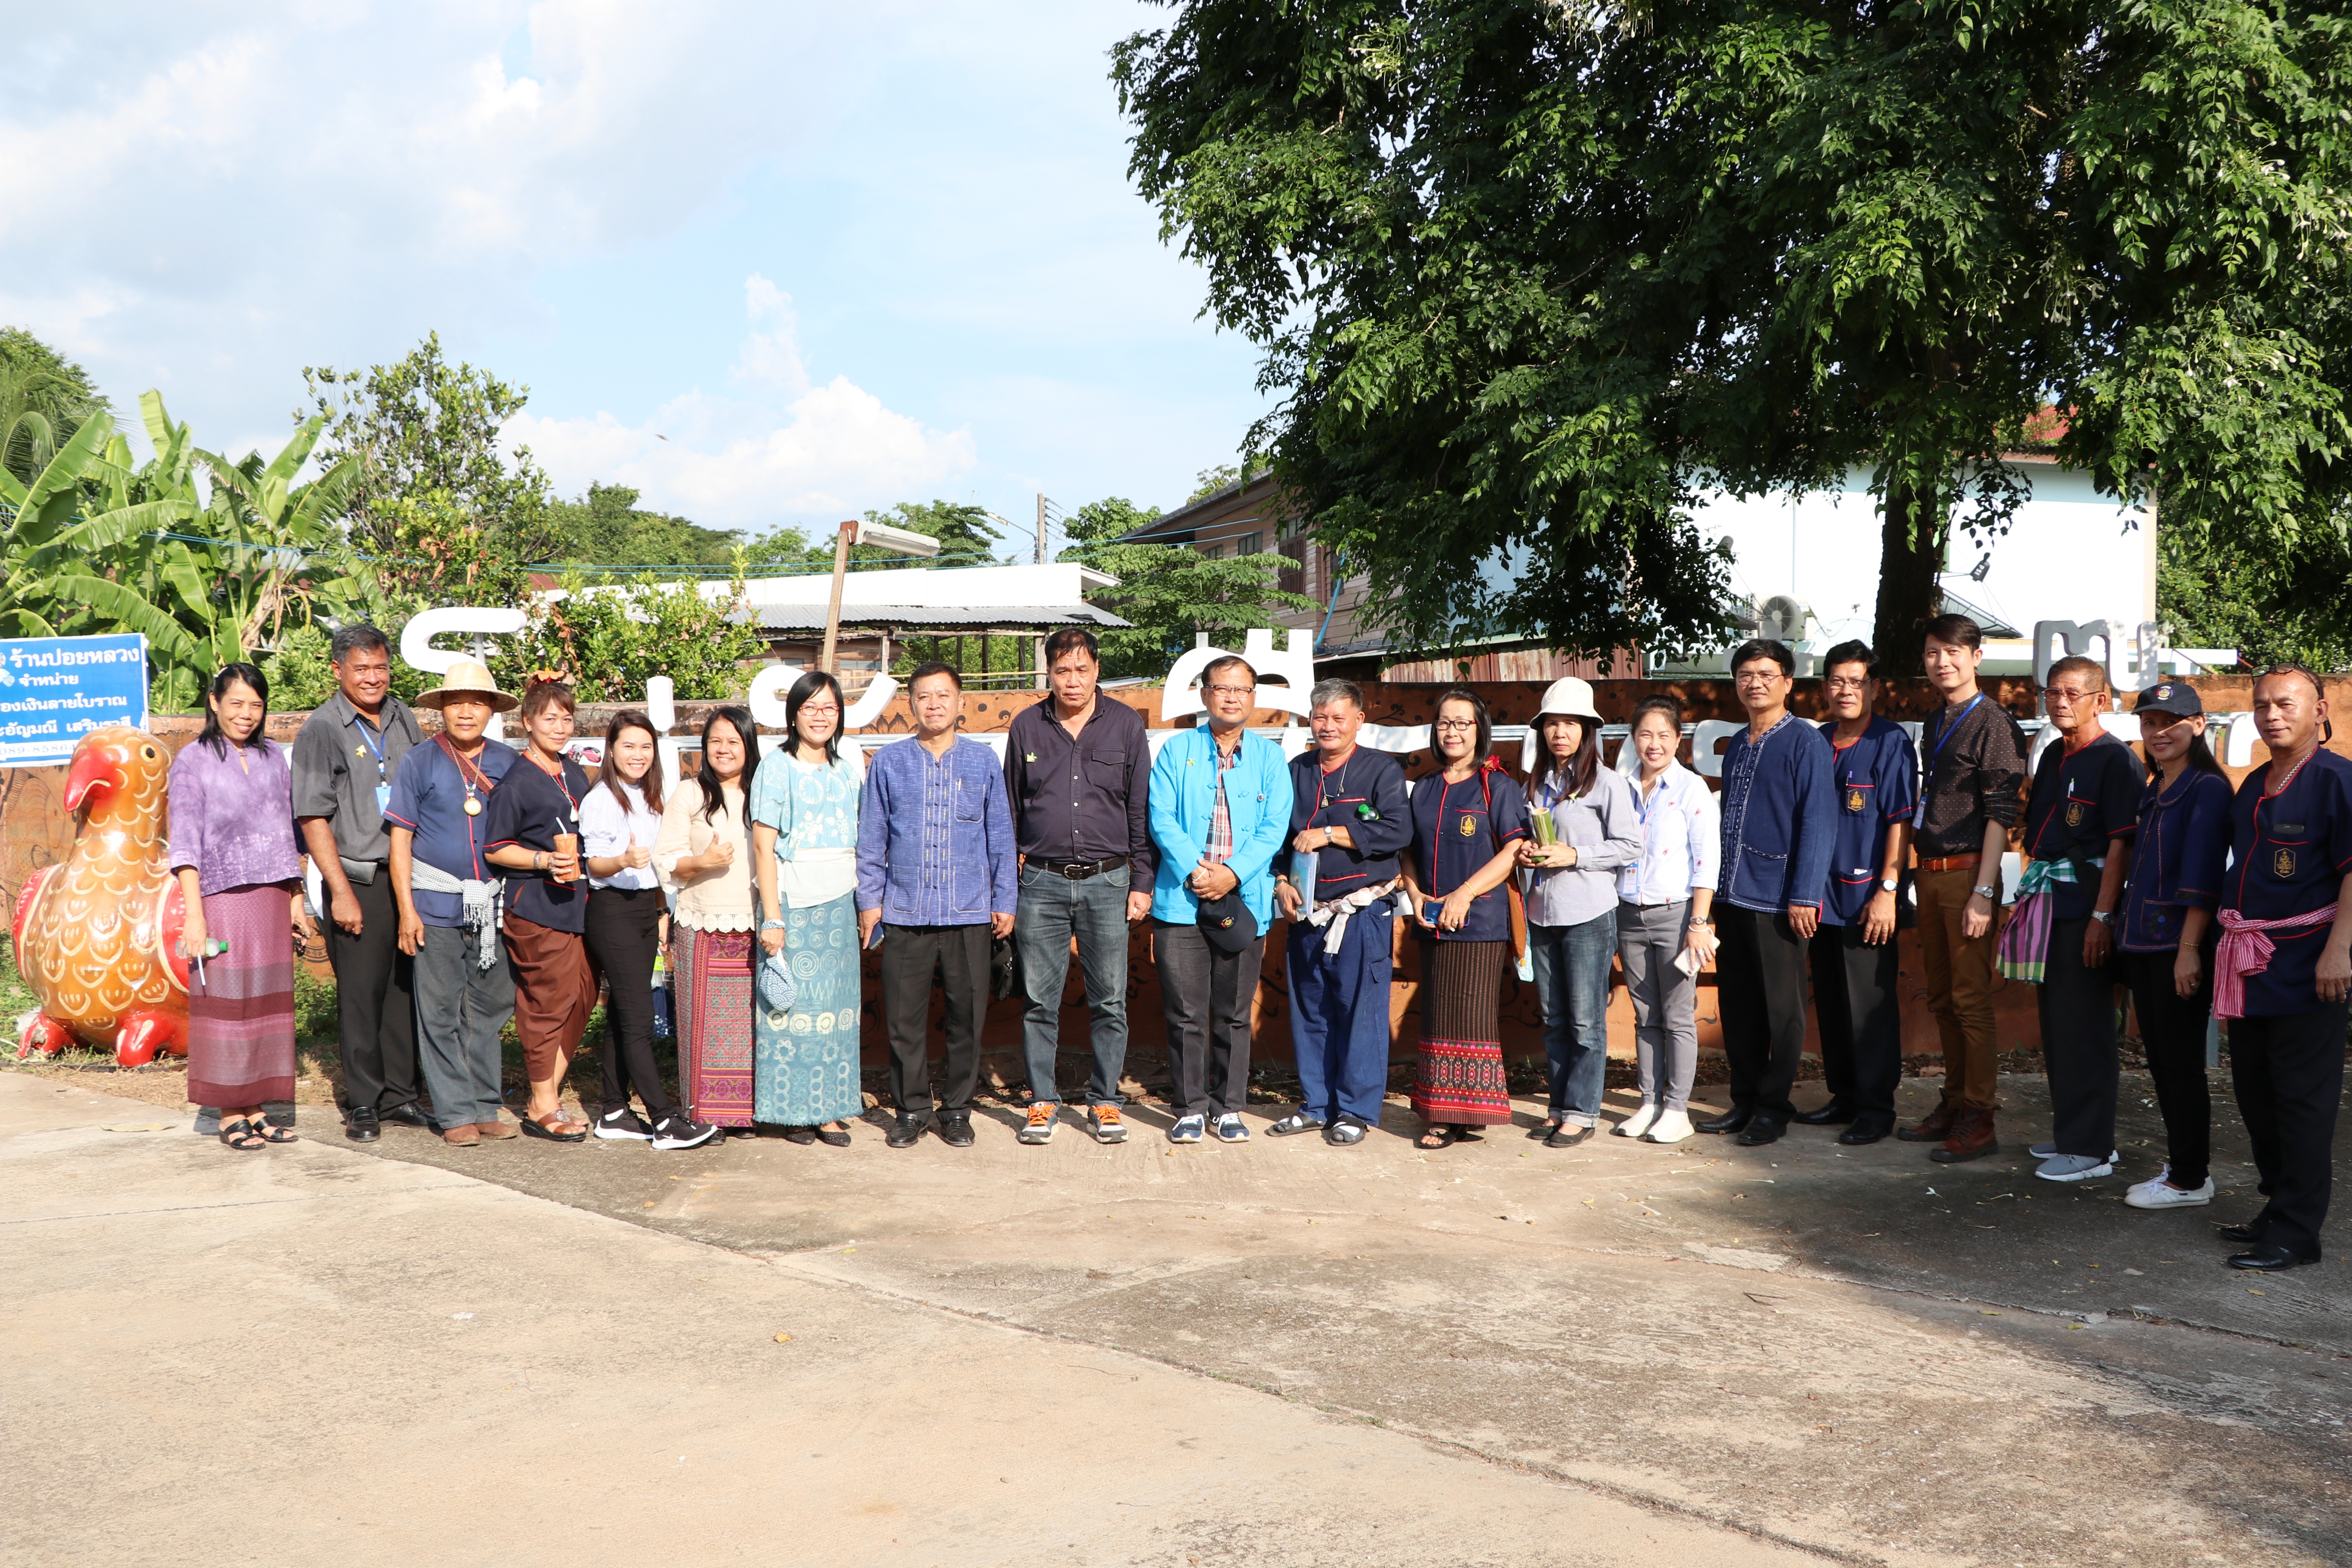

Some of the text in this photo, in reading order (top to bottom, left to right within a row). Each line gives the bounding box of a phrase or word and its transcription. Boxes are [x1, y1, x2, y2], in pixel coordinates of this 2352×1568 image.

[1974, 564, 1985, 575] PSI
[10, 648, 140, 668] ร้านปอยหลวง
[18, 672, 79, 687] จำหน่าย
